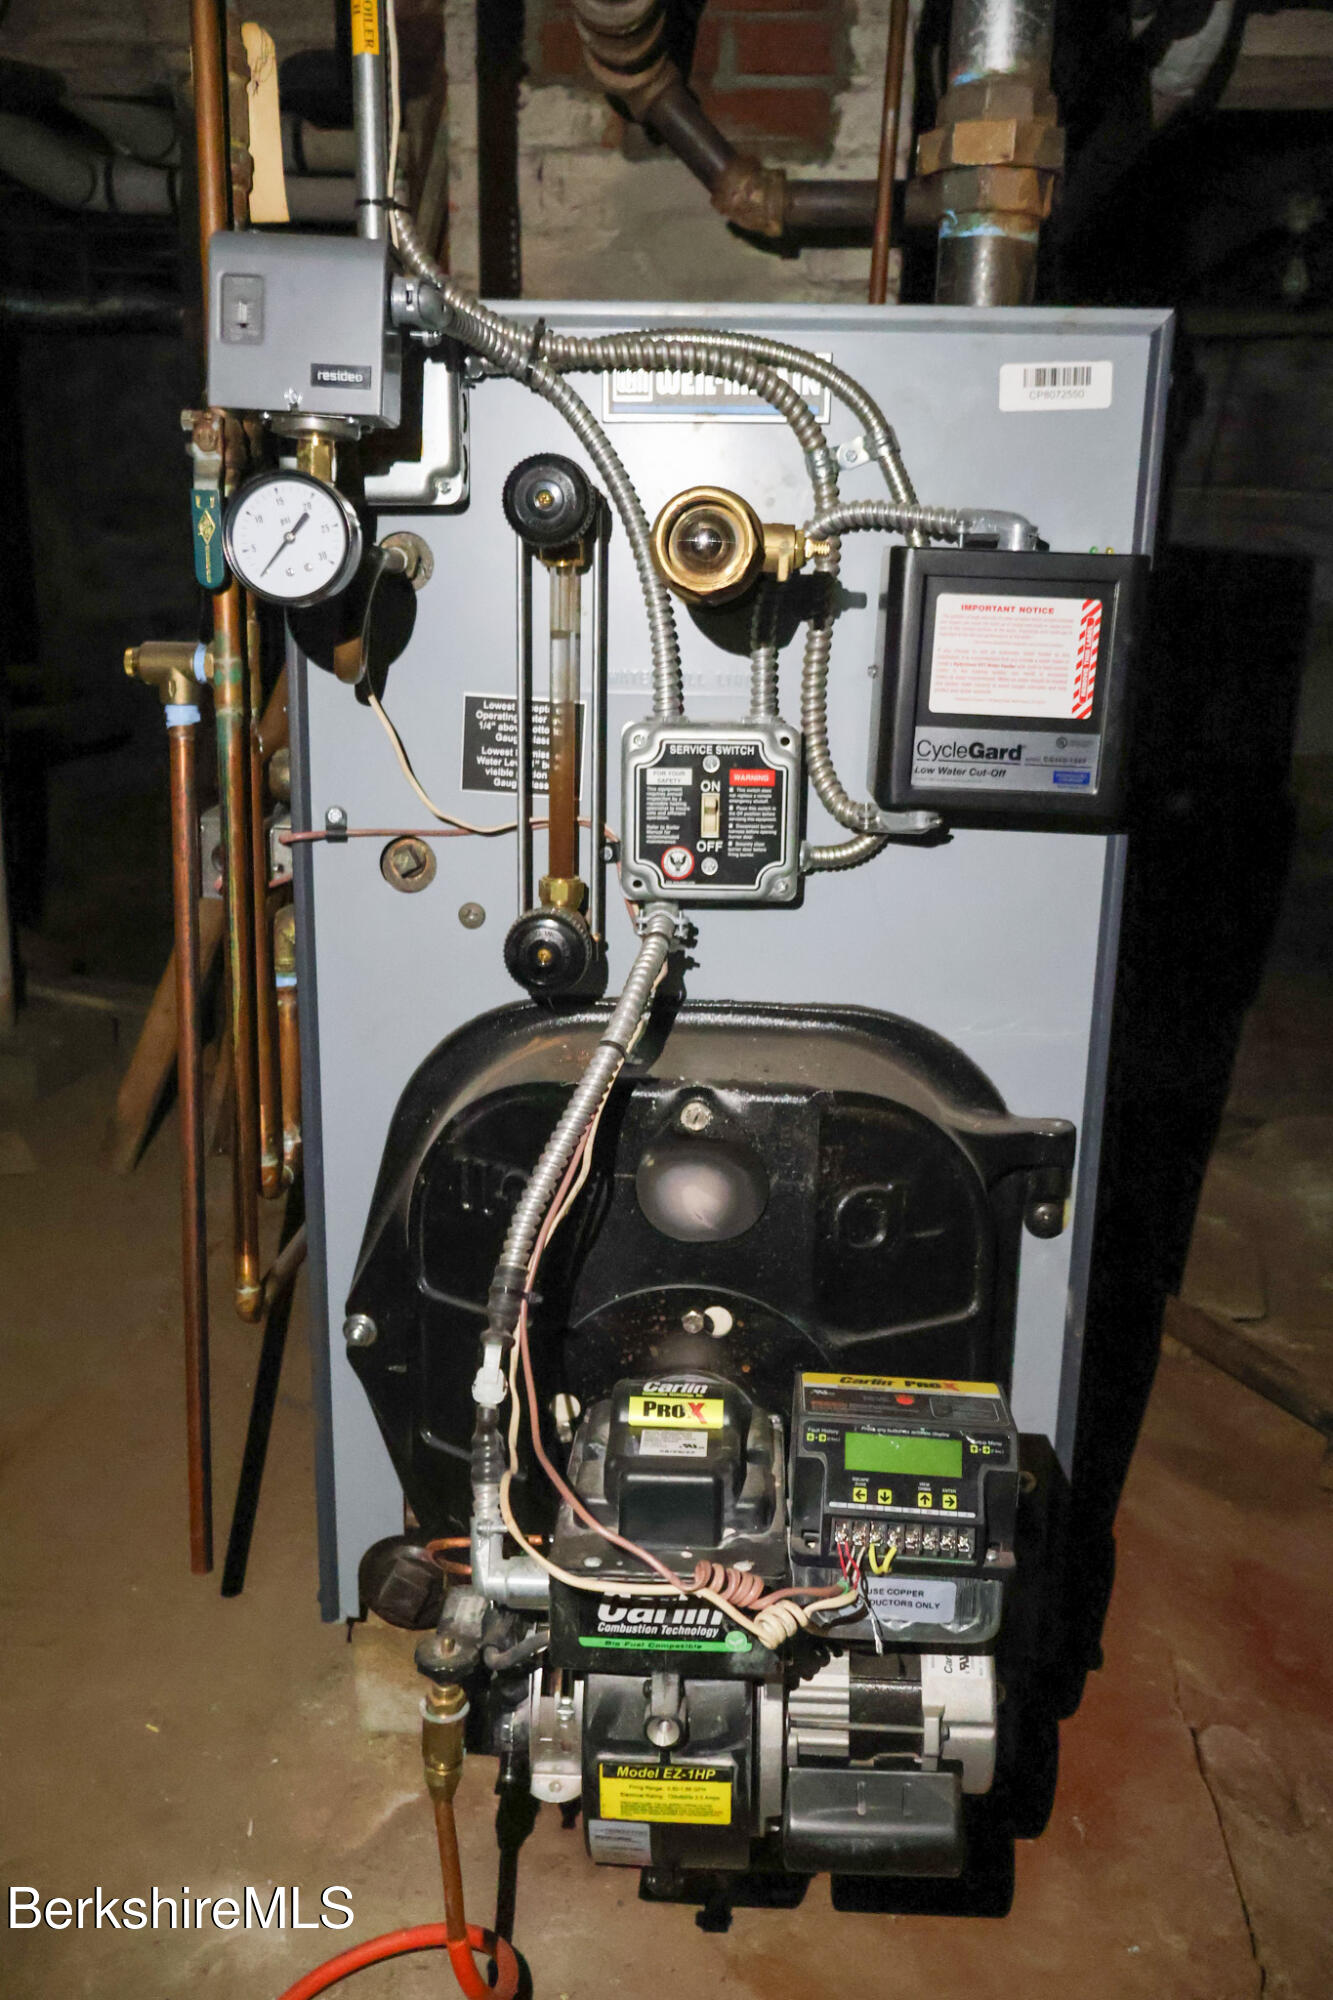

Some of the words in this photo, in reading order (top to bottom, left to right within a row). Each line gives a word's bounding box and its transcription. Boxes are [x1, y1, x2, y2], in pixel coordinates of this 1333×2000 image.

[317, 370, 363, 382] resideo
[961, 604, 1015, 613] IMPORTANT
[1019, 606, 1054, 615] NOTICE
[483, 700, 515, 711] Lowest
[481, 746, 513, 757] Lowest
[670, 744, 713, 756] SERVICE
[716, 745, 755, 756] SWITCH
[917, 739, 1023, 764] CycleGard
[476, 756, 502, 766] Water
[485, 767, 513, 778] visible
[914, 766, 935, 774] Low
[937, 766, 966, 776] Water
[969, 768, 1006, 778] Cut-Off
[700, 780, 721, 793] ON
[696, 841, 723, 853] OFF
[840, 1376, 894, 1387] Carlin
[643, 1381, 708, 1394] Carlin
[887, 1588, 924, 1597] COPPER
[916, 1601, 941, 1609] ONLY
[598, 1622, 658, 1635] Combustion
[661, 1624, 719, 1639] Technology
[648, 1642, 703, 1650] Compatible
[616, 1766, 659, 1779] Model
[662, 1767, 716, 1780] EZ-1HP
